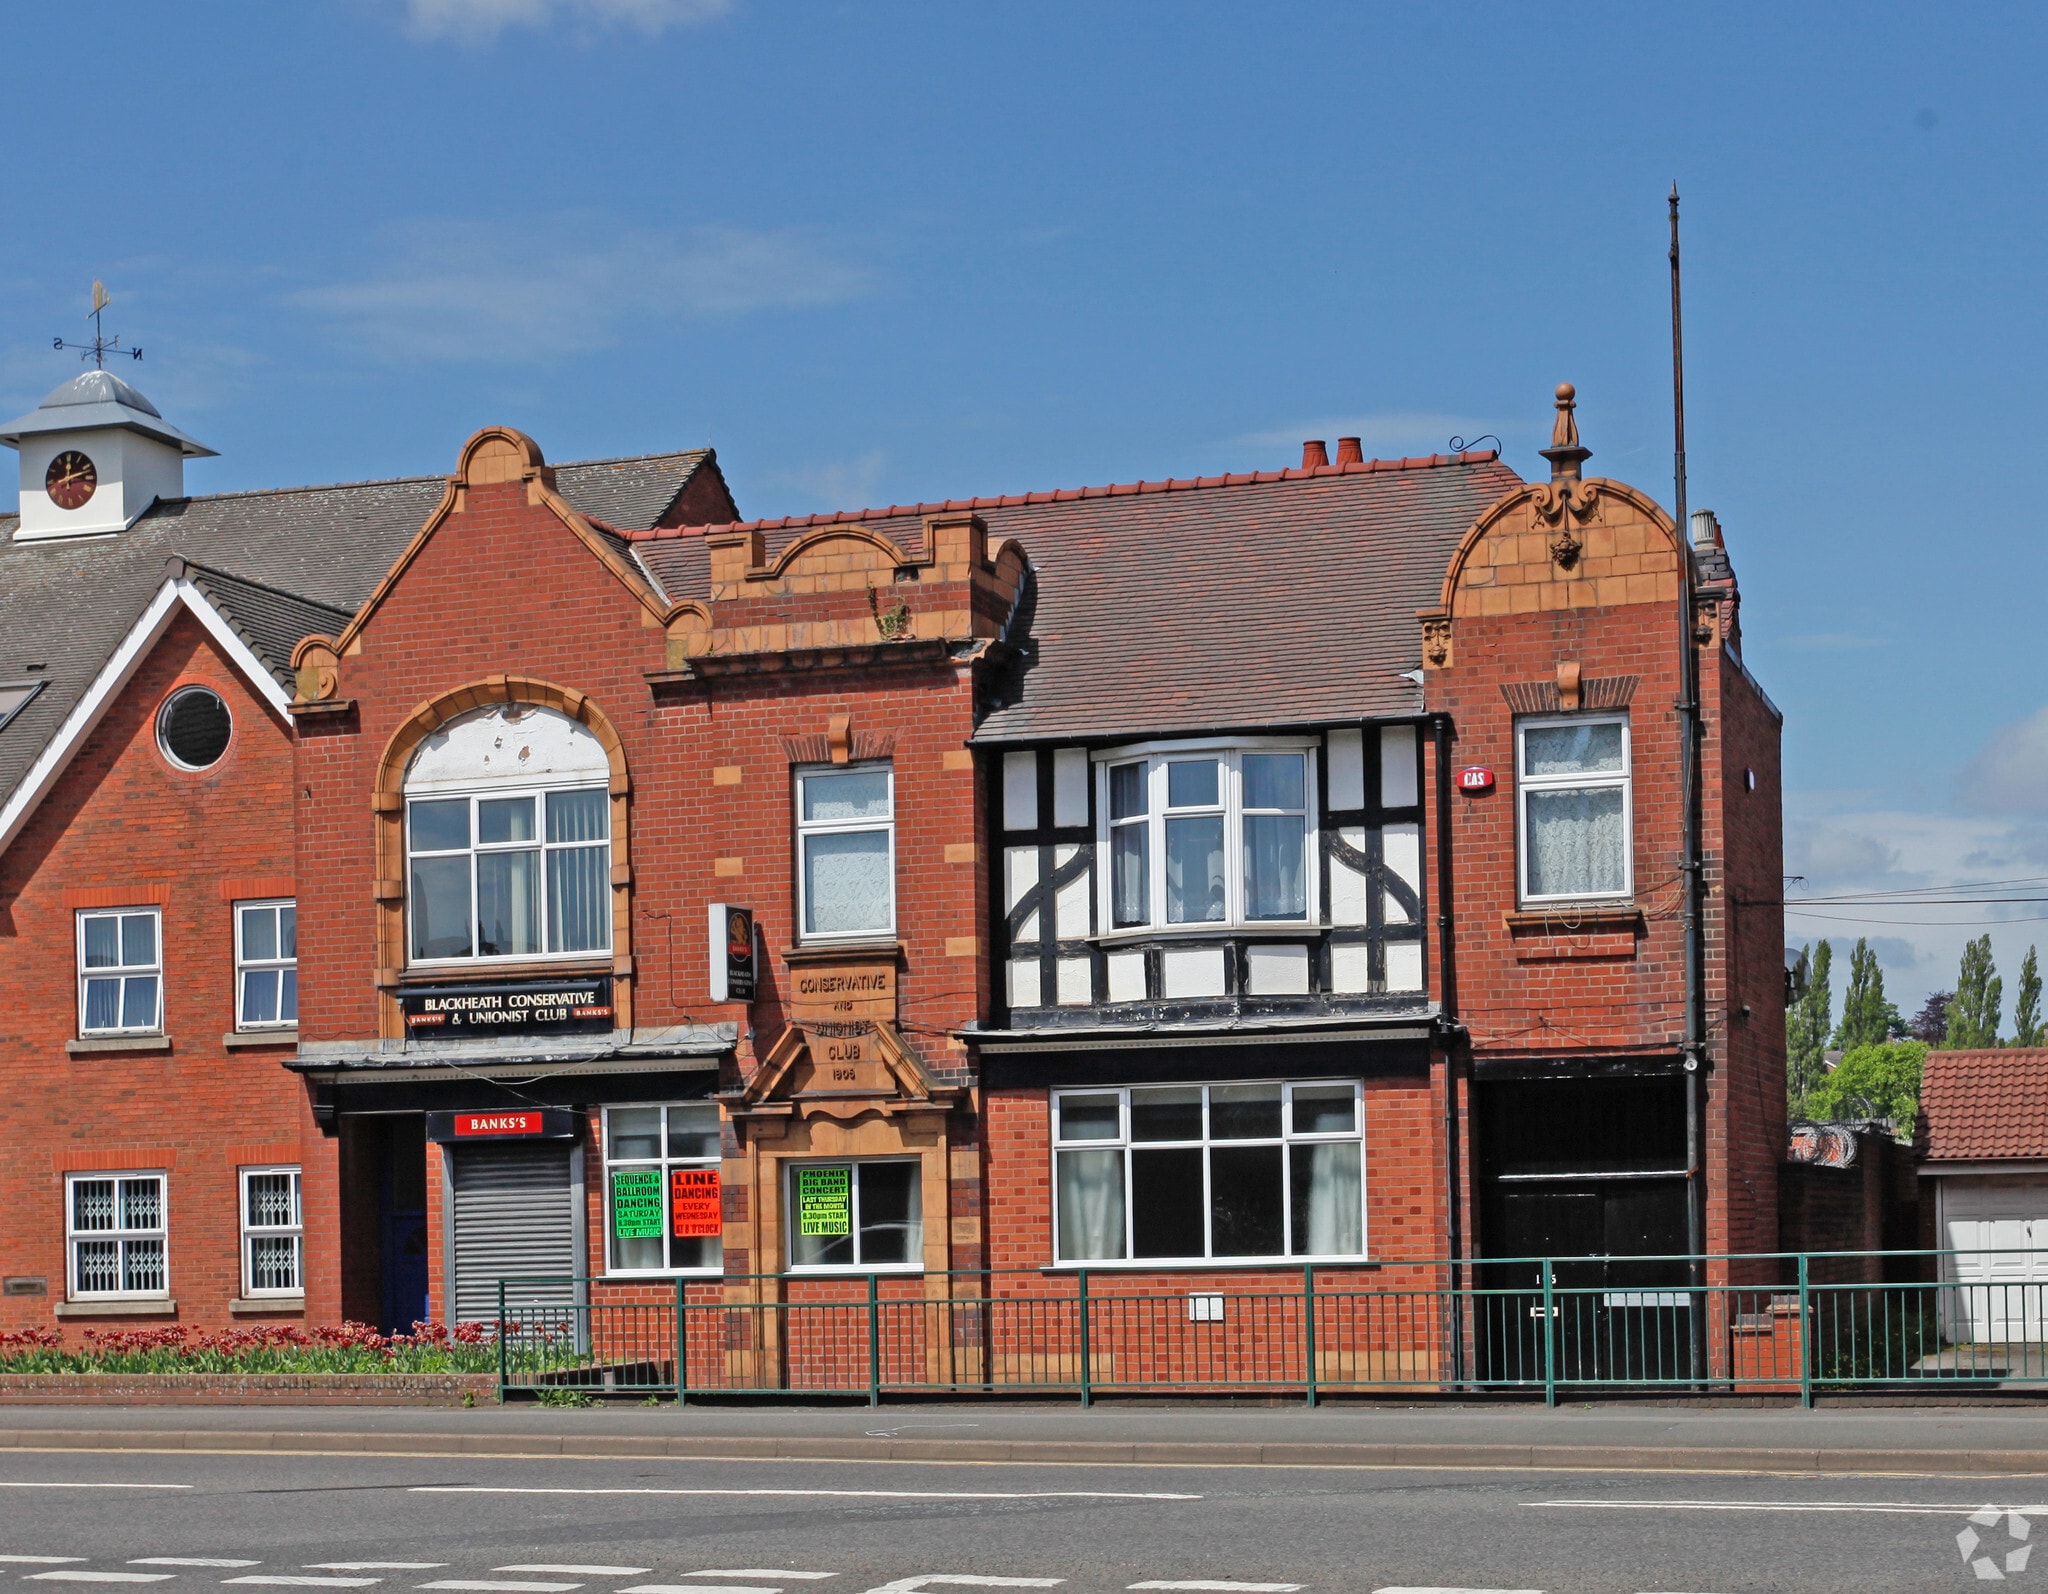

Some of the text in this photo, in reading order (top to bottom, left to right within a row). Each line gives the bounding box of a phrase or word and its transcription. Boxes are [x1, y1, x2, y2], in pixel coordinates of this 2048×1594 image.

[1464, 772, 1484, 786] CAS
[800, 974, 886, 994] CONSERVATIVE
[424, 992, 594, 1011] BLACKHEATH CONSERVATIVE
[834, 1000, 853, 1011] AND
[452, 1009, 567, 1024] & UNIONIST CLUB
[575, 1008, 608, 1017] BANKS'S
[411, 1015, 442, 1024] BANKS'S
[828, 1044, 860, 1060] CLUB
[471, 1117, 526, 1130] BANKS'S
[616, 1174, 652, 1185] SEQUENCE
[676, 1174, 717, 1185] LINE
[616, 1186, 659, 1196] BALLROOM
[675, 1188, 718, 1199] DANCING
[617, 1198, 660, 1208] DANCING
[618, 1210, 660, 1218] SATURDAY
[676, 1212, 718, 1220] WEDNESDAY
[642, 1218, 660, 1226] START
[804, 1222, 847, 1233] LIVE MUSIC
[636, 1228, 661, 1236] MUSIC
[1536, 1274, 1556, 1284] 15
